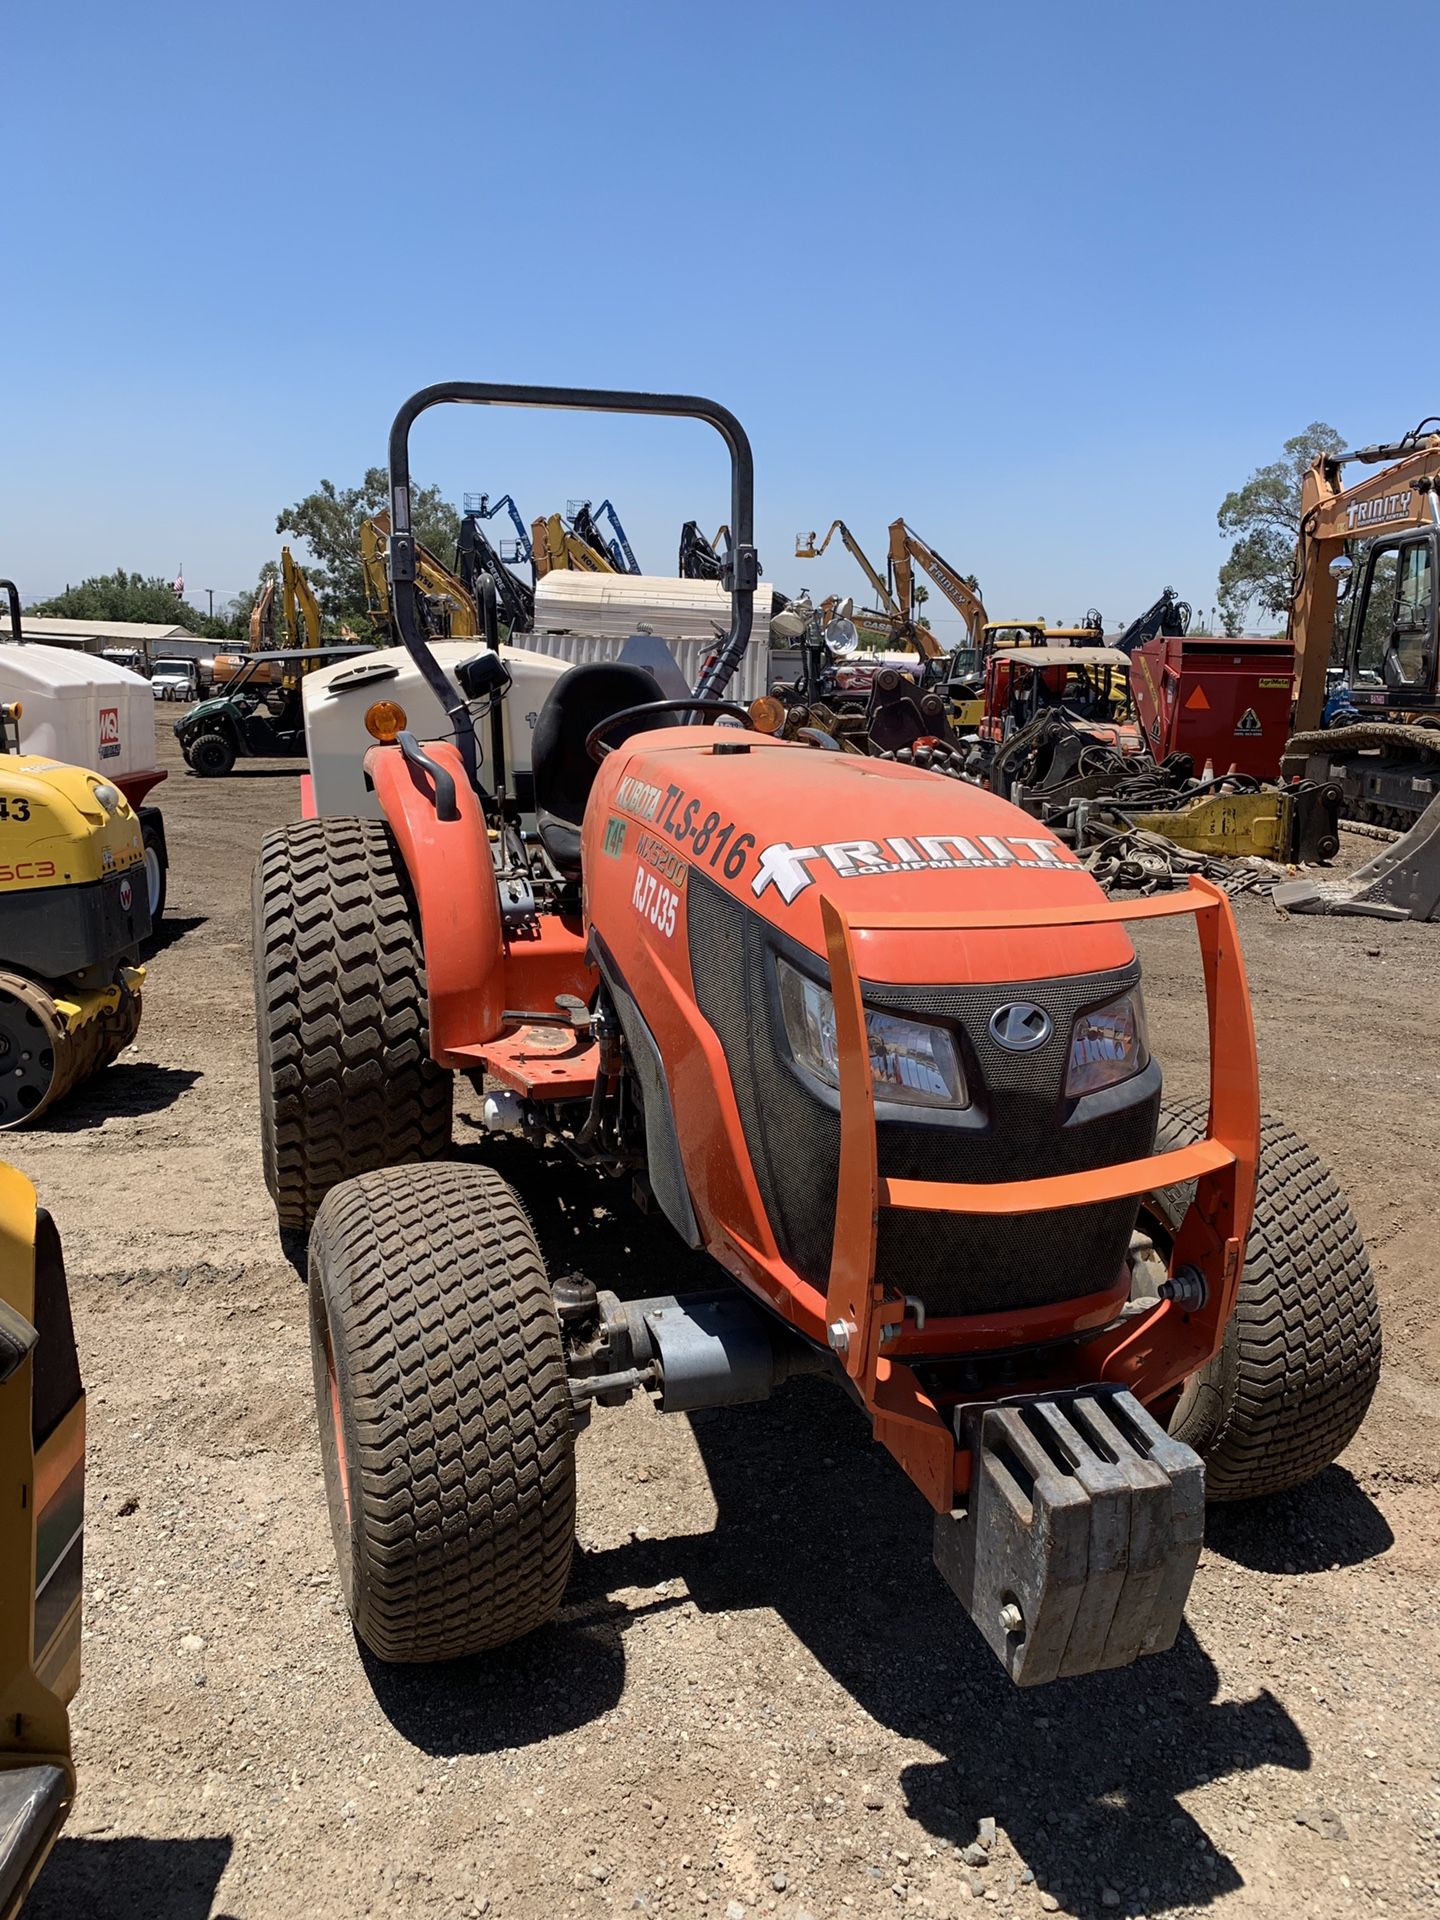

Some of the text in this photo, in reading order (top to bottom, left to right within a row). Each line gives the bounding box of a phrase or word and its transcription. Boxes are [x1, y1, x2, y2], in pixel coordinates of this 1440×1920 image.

[1346, 488, 1412, 530] TRINITY
[486, 560, 506, 591] DEERE
[928, 560, 967, 604] TRINITY
[603, 817, 628, 857] T4F
[616, 775, 757, 880] KUBOTA TLS-816
[636, 830, 690, 889] MX5200
[840, 858, 1011, 878] EQUIPMENT
[632, 865, 679, 939] RJ7J35
